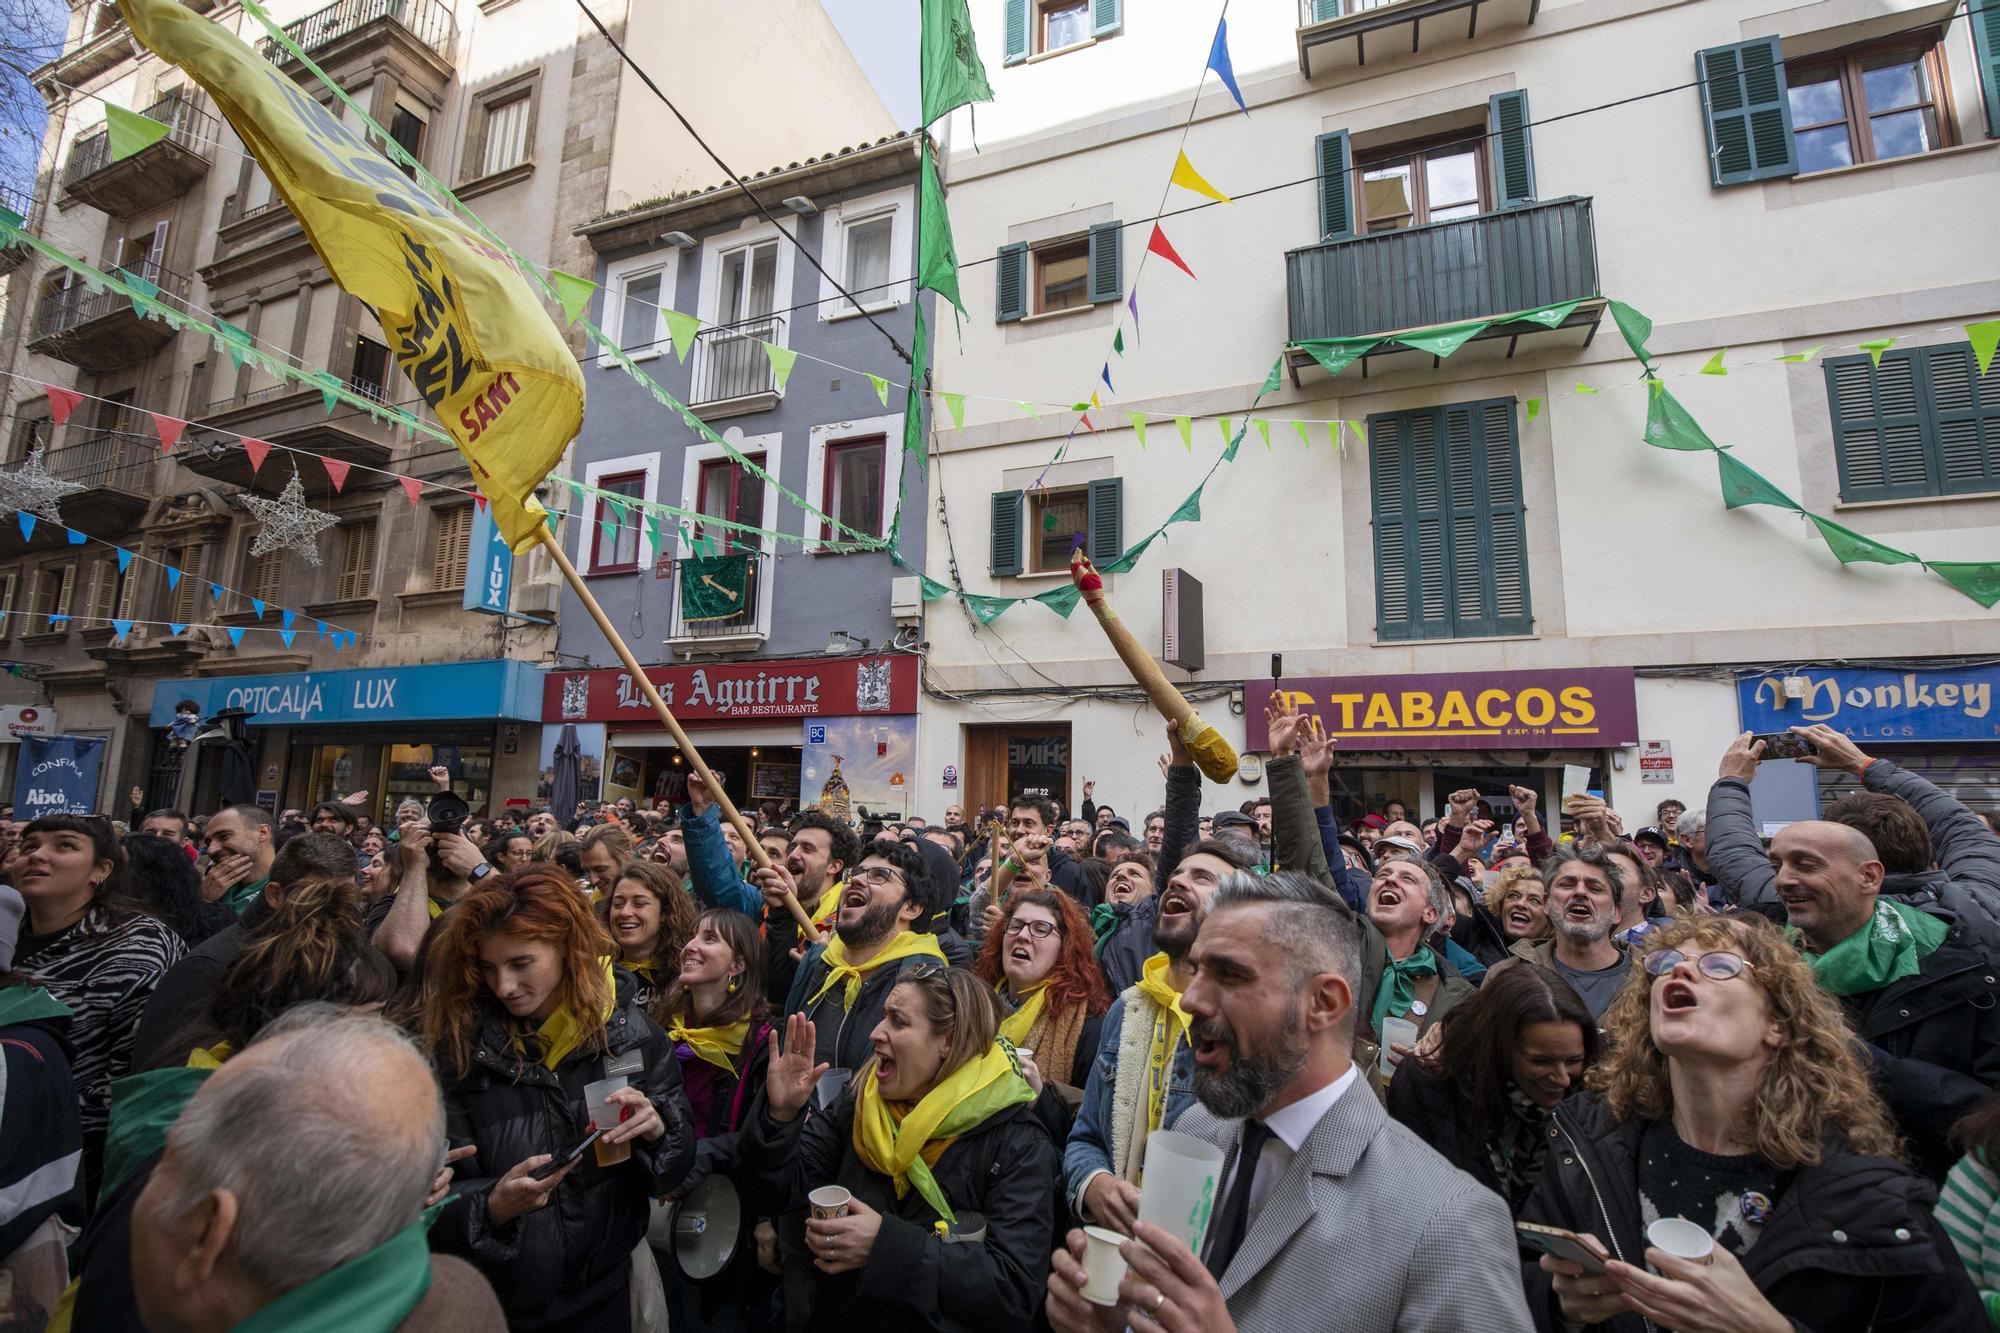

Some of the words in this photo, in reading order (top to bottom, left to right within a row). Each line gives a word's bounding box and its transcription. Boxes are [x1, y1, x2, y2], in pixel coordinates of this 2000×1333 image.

[487, 555, 503, 607] LUX
[353, 678, 397, 709] LUX
[684, 668, 820, 713] Aguirre
[1755, 673, 1991, 721] Monkey
[731, 706, 750, 715] BAR
[751, 704, 819, 714] RESTAURANTE
[1331, 686, 1596, 729] TABACOS
[8, 723, 45, 732] General
[811, 728, 824, 738] BC
[25, 788, 65, 805] Això
